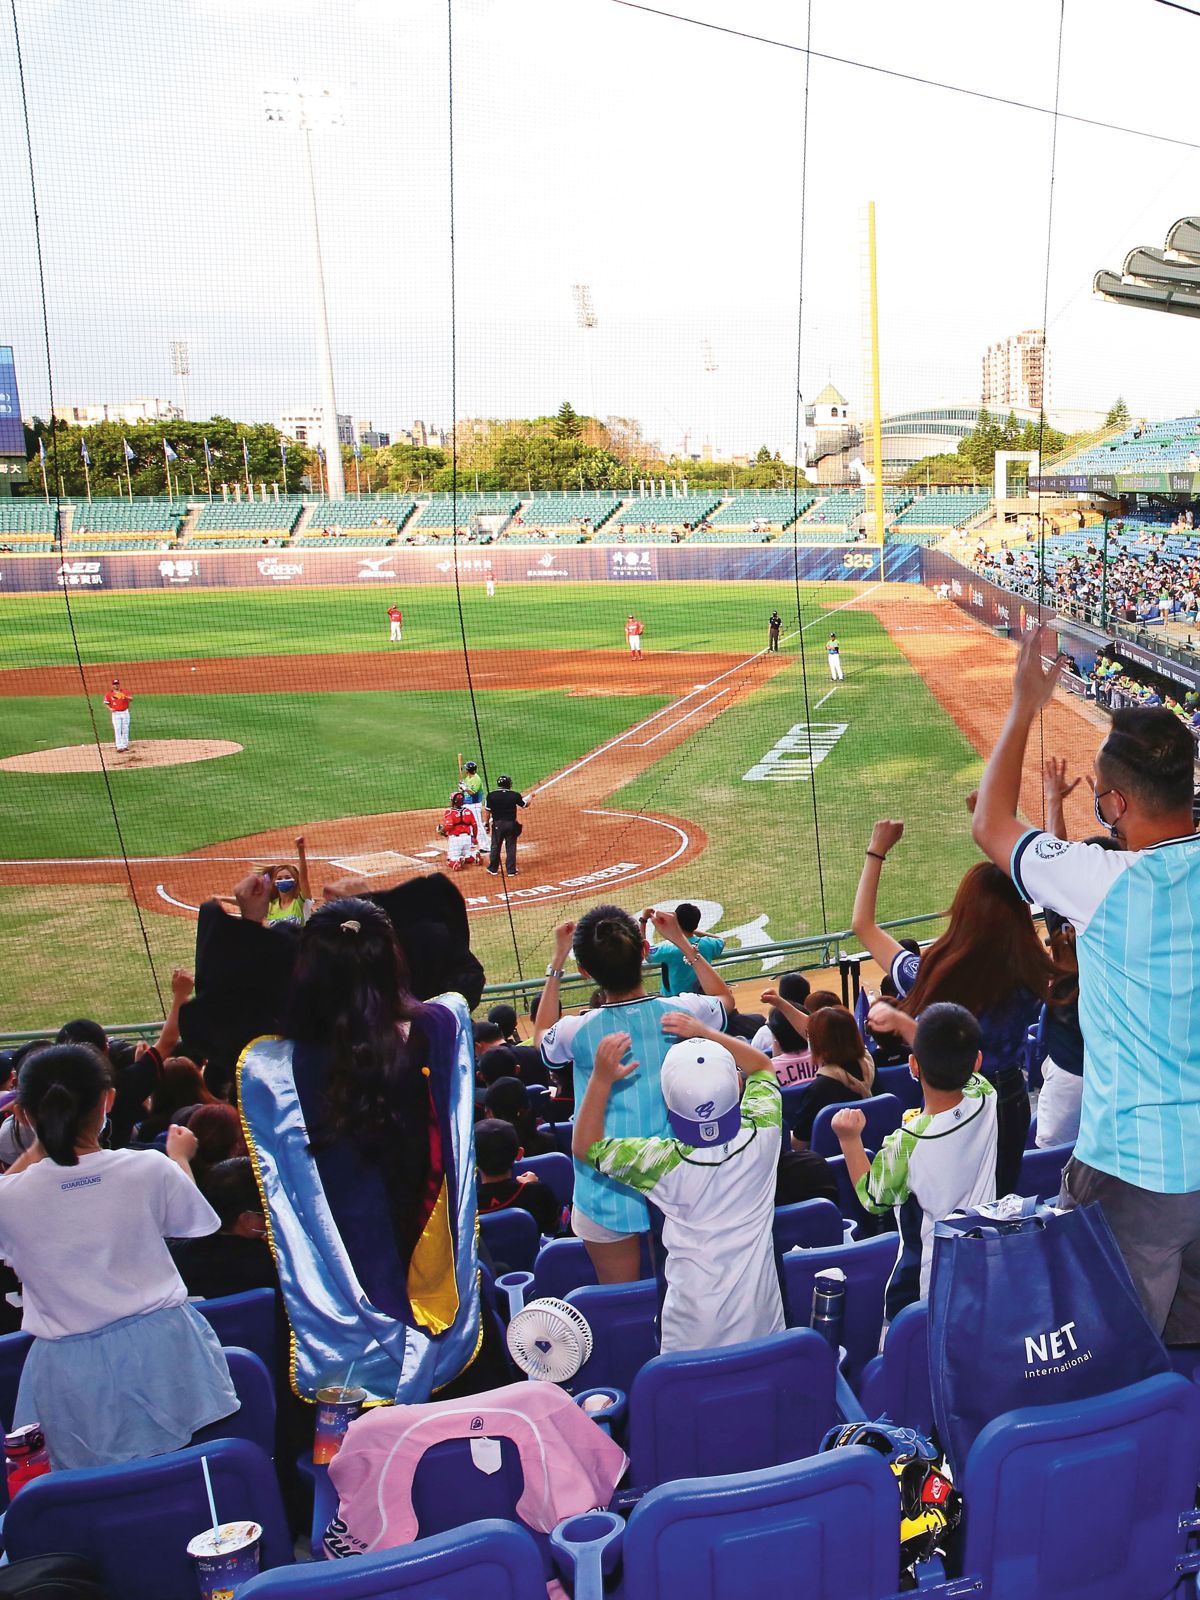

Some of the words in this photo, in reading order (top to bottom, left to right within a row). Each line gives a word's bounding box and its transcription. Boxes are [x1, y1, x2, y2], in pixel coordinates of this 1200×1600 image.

[259, 563, 304, 576] GREEN
[843, 553, 874, 569] 325
[495, 885, 561, 901] FOR
[559, 862, 641, 887] GREEN
[776, 1062, 820, 1086] C.CHIA
[61, 1176, 101, 1190] GUARDIANS
[1024, 1321, 1077, 1364] NET
[1024, 1349, 1093, 1379] International
